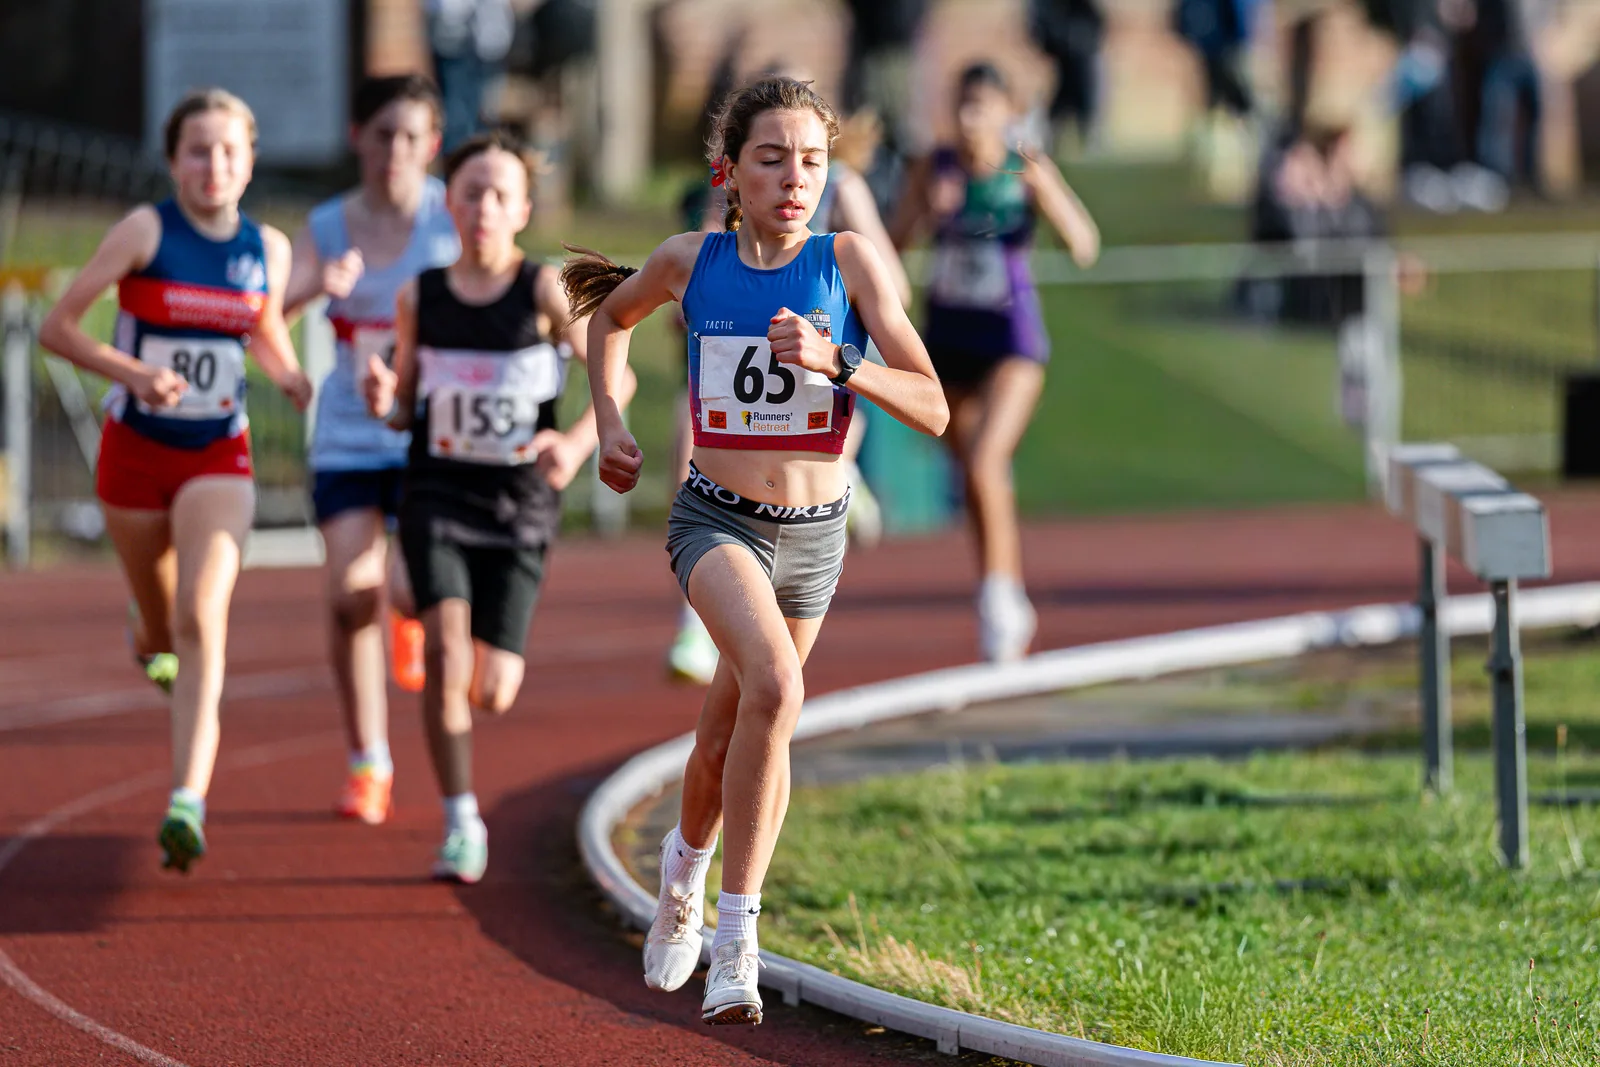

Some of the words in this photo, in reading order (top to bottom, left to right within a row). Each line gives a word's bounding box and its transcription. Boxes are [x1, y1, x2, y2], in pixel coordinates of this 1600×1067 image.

[705, 320, 734, 330] TACTIC
[173, 350, 216, 392] 80
[733, 345, 796, 404] 65
[753, 411, 793, 422] Runners'
[753, 422, 790, 432] Retreat
[754, 502, 832, 519] NIKE
